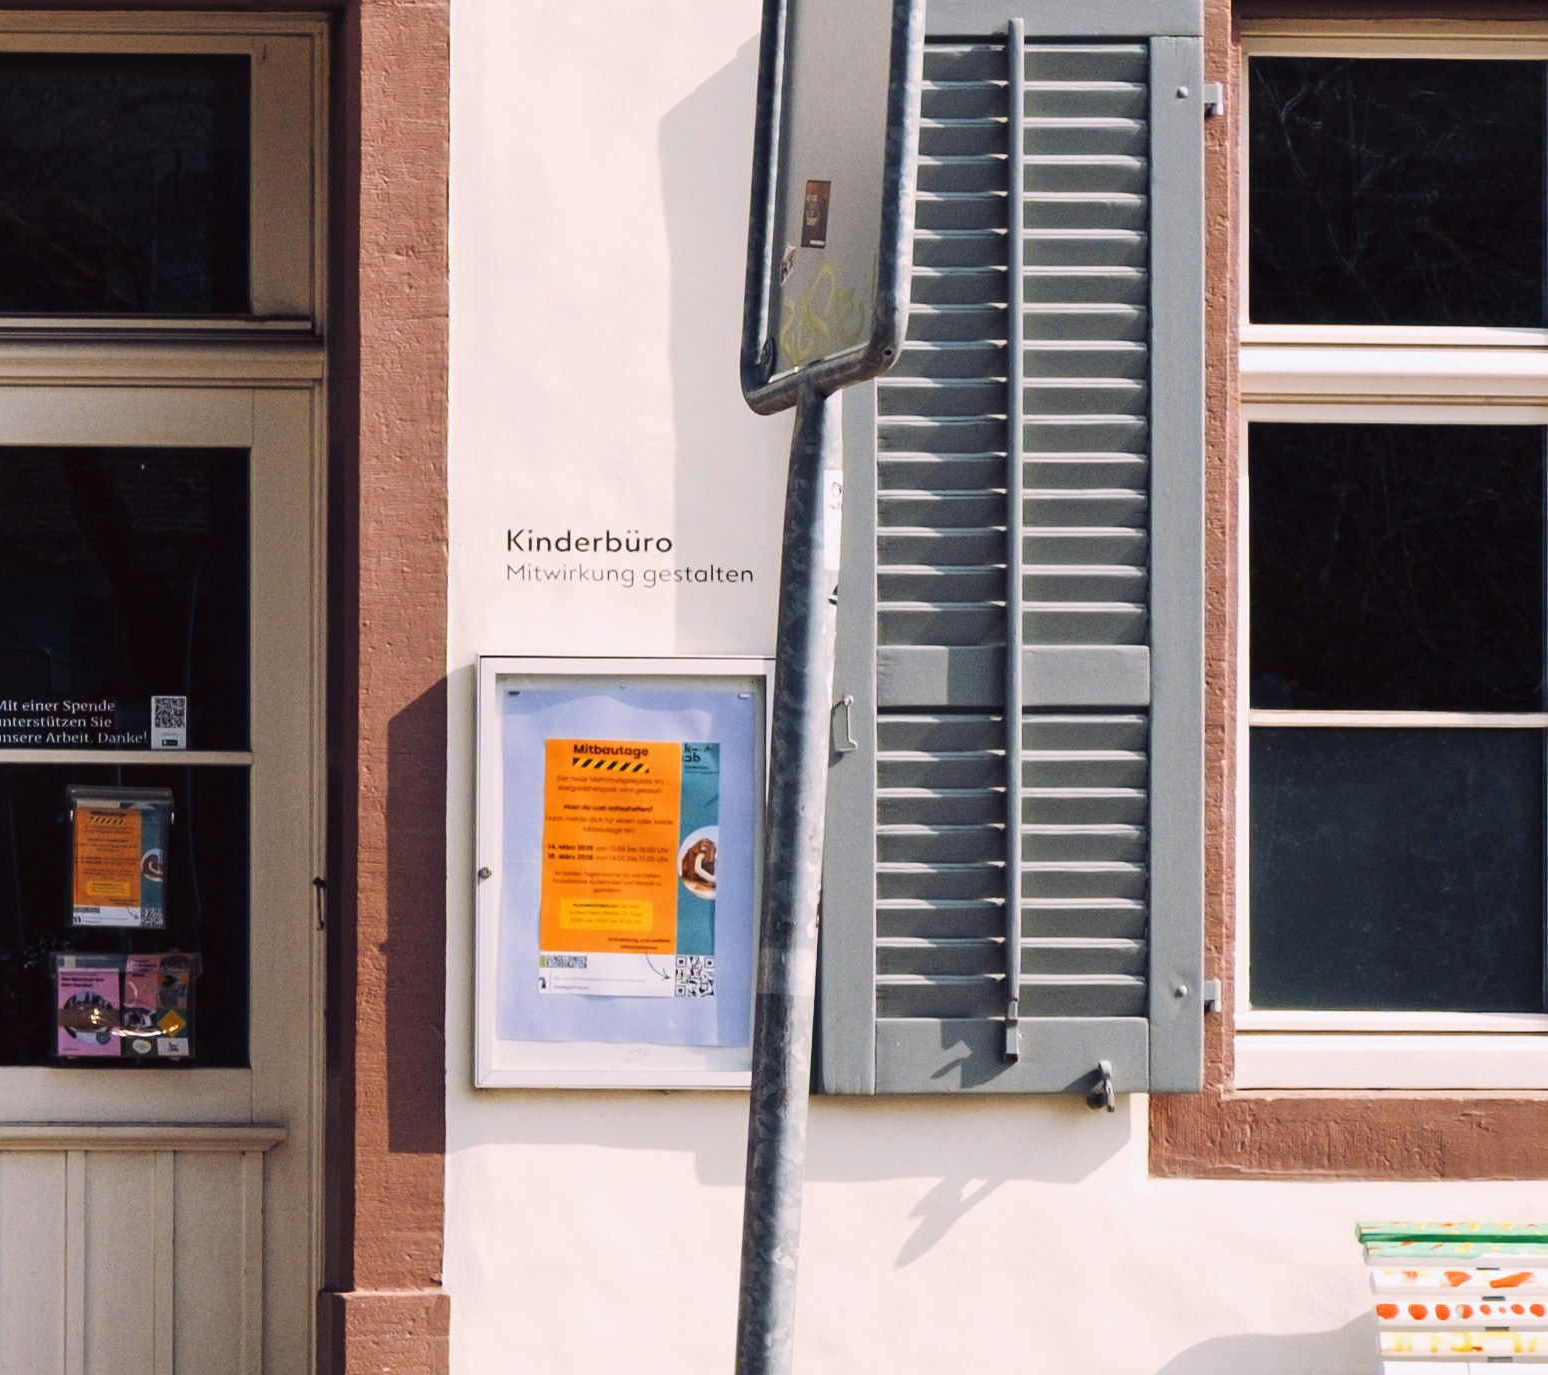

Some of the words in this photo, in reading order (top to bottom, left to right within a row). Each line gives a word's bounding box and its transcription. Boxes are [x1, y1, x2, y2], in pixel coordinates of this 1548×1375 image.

[506, 529, 673, 553] Kinderbüro
[506, 564, 635, 589] Mitwirkung
[643, 564, 755, 589] gestalten
[21, 700, 59, 712] einer
[62, 699, 116, 715] Spende
[90, 716, 112, 728] Sie
[45, 731, 94, 744] Arbeit.
[97, 731, 148, 745] Danke!
[573, 743, 649, 760] Mitbautage
